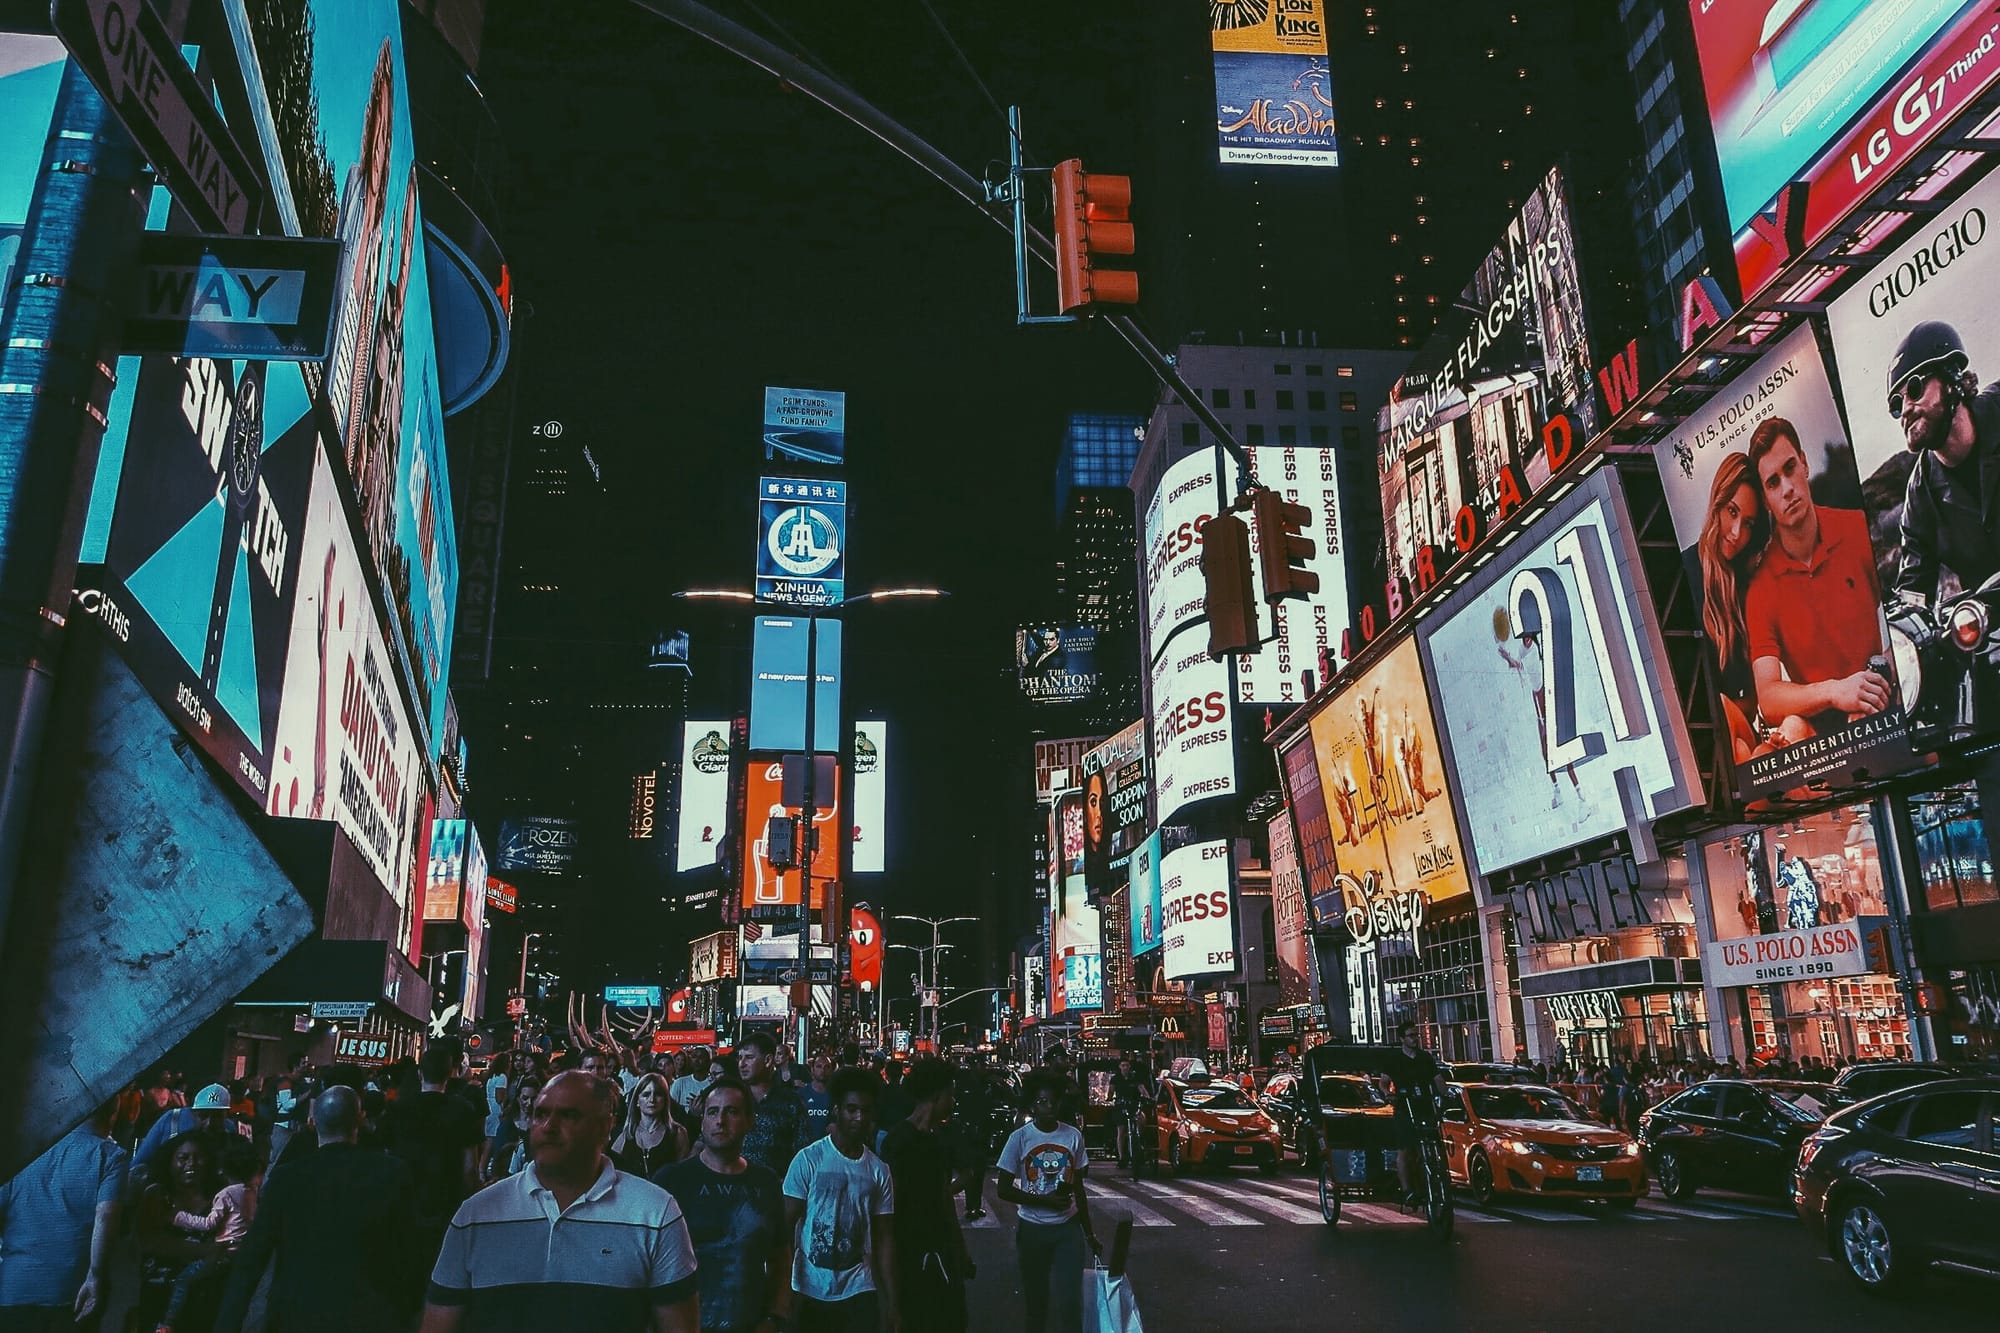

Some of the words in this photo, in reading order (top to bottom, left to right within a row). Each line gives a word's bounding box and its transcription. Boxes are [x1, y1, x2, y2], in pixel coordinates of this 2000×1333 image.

[1275, 14, 1321, 36] KING
[104, 1, 165, 122] ONE
[186, 121, 239, 222] WAY
[1218, 99, 1335, 136] Aladdin
[1850, 128, 1892, 184] LG
[1892, 75, 1946, 137] G7
[1868, 207, 1987, 318] GIORGIO
[150, 271, 280, 318] WAY
[1383, 358, 1456, 475] MARQUEE
[1457, 226, 1563, 380] FLAGSHIPS
[1695, 422, 1720, 450] U.S.
[1718, 393, 1756, 434] POLO
[1754, 361, 1799, 408] ASSN.
[1720, 423, 1748, 449] SINCE
[180, 357, 288, 598] SWTCH
[1168, 472, 1213, 504] EXPRESS
[1323, 489, 1339, 555] EXPRESS
[1149, 514, 1213, 597] EXPRESS
[1172, 554, 1202, 578] EXPRE
[763, 592, 793, 602] NEWS
[775, 582, 826, 595] XINHUA
[1174, 598, 1205, 620] EXPRE
[1277, 604, 1291, 674] EXPRESS
[1313, 605, 1328, 653] EXPRE
[1508, 524, 1652, 775] 21
[1019, 674, 1097, 690] PHANTOM
[1026, 688, 1039, 696] OF
[1040, 687, 1060, 696] THE
[1060, 686, 1091, 695] OPERA
[1047, 669, 1068, 677] THE
[341, 650, 379, 781] DAVID
[1155, 691, 1226, 759] EXPRESS
[694, 753, 730, 763] Green
[1083, 731, 1133, 779] KENDALL
[1181, 729, 1227, 753] EXPRESS
[1751, 757, 1778, 775] LIVE
[1784, 711, 1901, 764] AUTHENTICALLY
[1753, 775, 1773, 786] PAMELA
[1773, 763, 1803, 780] FLANAGAN
[1858, 738, 1877, 750] POLO
[1878, 728, 1907, 744] PLAYERS
[640, 770, 656, 839] NOVOTEL
[1183, 777, 1230, 799] EXPRESS
[1119, 801, 1144, 827] SOON
[520, 828, 579, 847] FROZEN
[1413, 847, 1434, 879] LION
[1431, 844, 1455, 870] KING
[1276, 869, 1301, 900] HARRY
[1507, 852, 1652, 947] FOREVER
[776, 905, 786, 916] 45
[1162, 891, 1229, 932] EXPRESS
[1104, 904, 1117, 987] PALACE
[1722, 943, 1754, 966] U.S.
[1756, 935, 1807, 963] POLO
[1755, 966, 1794, 979] SINCE
[1799, 961, 1834, 975] 1890
[1546, 991, 1605, 1021] FOREVER
[1602, 990, 1623, 1018] 21
[339, 1038, 388, 1058] JESUS
